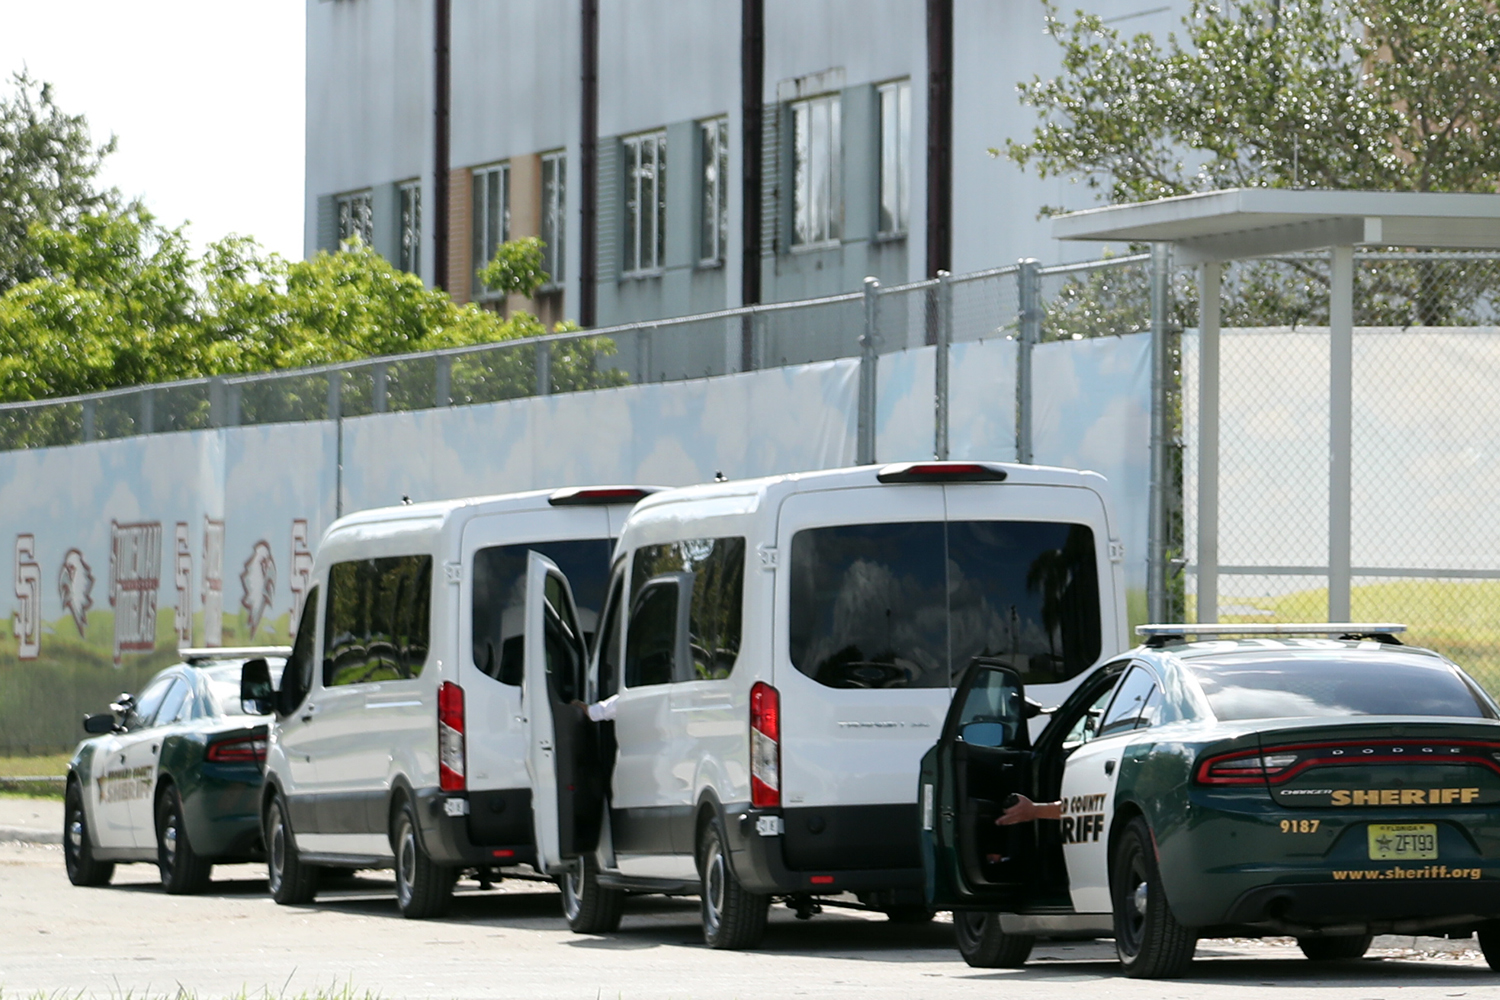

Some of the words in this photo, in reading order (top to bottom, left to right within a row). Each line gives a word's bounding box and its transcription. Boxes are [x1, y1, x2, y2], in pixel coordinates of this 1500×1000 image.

[1332, 747, 1461, 756] DODGE
[1071, 793, 1107, 813] COUNTY
[1331, 788, 1479, 806] SHERIFF
[1280, 819, 1320, 834] 9187
[1395, 834, 1434, 852] ZFT93
[1332, 866, 1482, 880] www.sheriff.org
